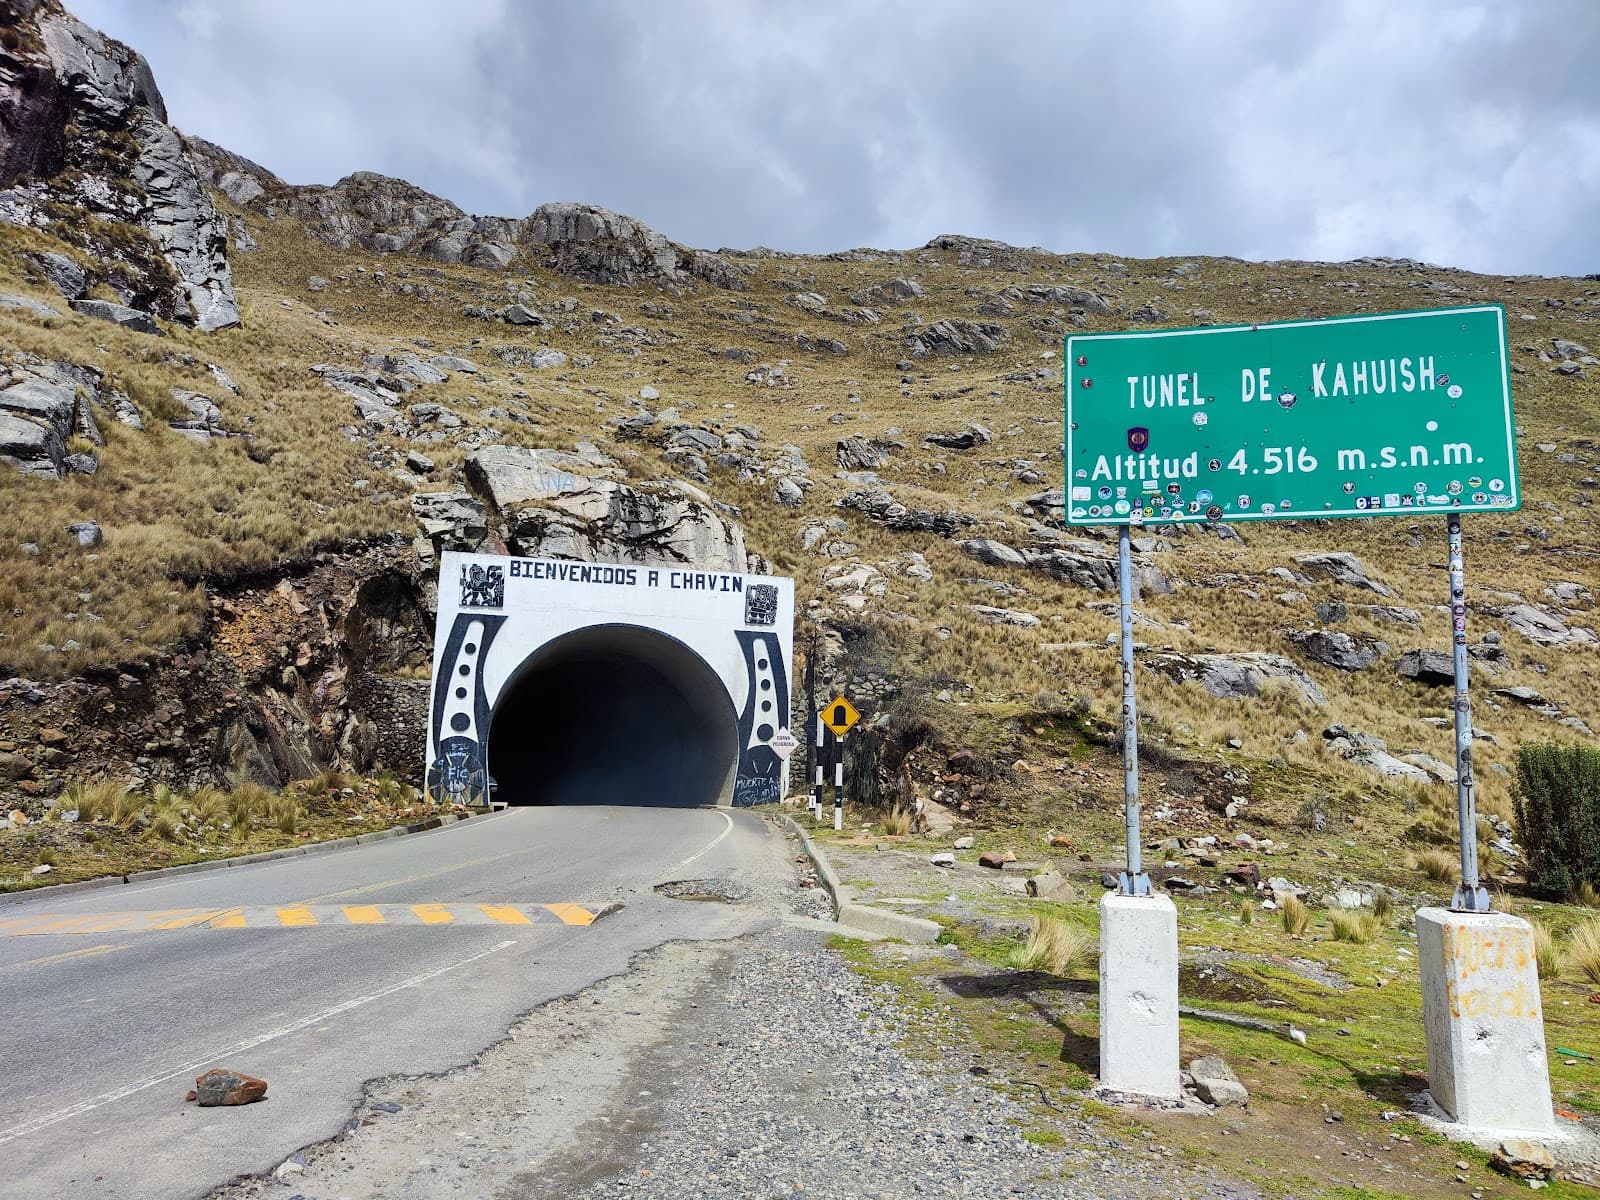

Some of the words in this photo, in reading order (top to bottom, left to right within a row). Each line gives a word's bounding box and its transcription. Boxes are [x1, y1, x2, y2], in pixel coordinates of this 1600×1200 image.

[1127, 372, 1205, 409] TUNEL
[1241, 367, 1272, 403] DE
[1312, 355, 1436, 398] KAHUISH
[1091, 451, 1198, 481] Altitud
[1227, 446, 1318, 476] 4.516
[1337, 442, 1484, 471] m.s.n.m.
[510, 559, 637, 586] BIENVENIDOS
[648, 570, 659, 587] A
[671, 572, 743, 593] CHAVIN
